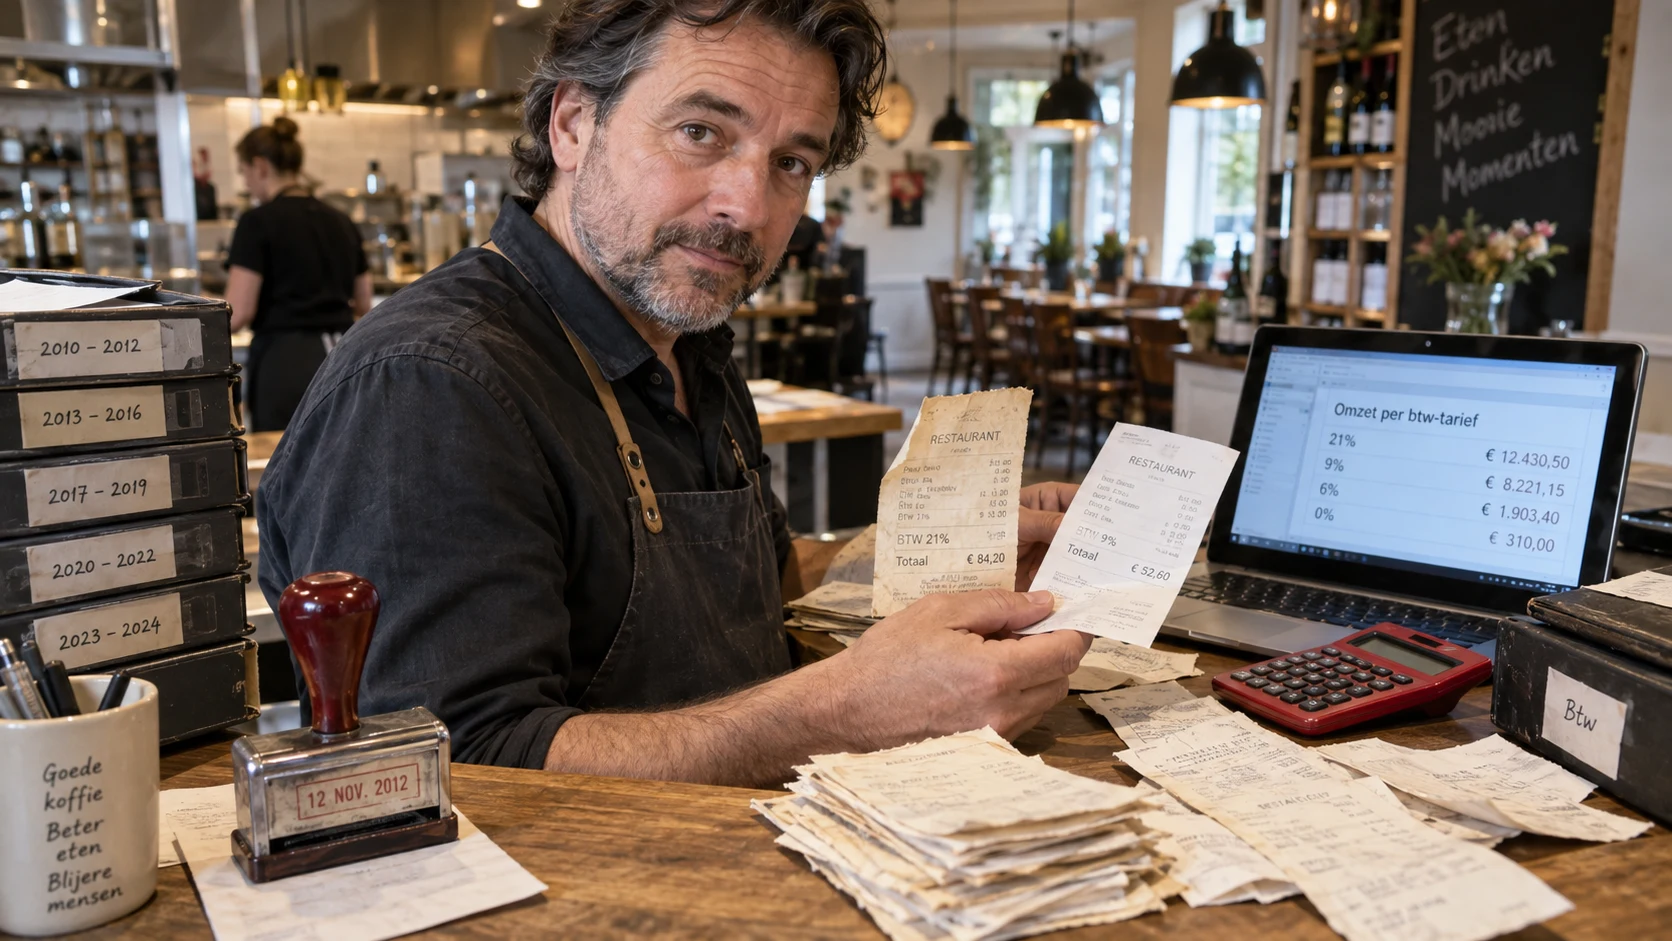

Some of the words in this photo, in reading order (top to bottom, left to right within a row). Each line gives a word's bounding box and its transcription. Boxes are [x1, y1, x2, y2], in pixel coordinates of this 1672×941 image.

[1431, 9, 1508, 62] Eten
[1434, 98, 1524, 160] Mooie
[1442, 130, 1580, 203] Momenten
[40, 341, 80, 357] 2010
[103, 338, 142, 354] 2012
[42, 409, 82, 427] 2013
[105, 404, 142, 422] 2016
[1334, 402, 1377, 419] Omzet
[1380, 409, 1404, 423] per
[1408, 408, 1479, 428] btw-tarief
[930, 430, 1001, 445] RESTAURANT
[1328, 432, 1356, 448] 21%
[1485, 448, 1496, 462] €
[1501, 450, 1570, 470] 12.430,50
[1128, 455, 1196, 480] RESTAURANT
[1324, 457, 1344, 472] 9%
[1485, 475, 1495, 489] €
[1503, 477, 1565, 497] 8.221,15
[48, 485, 88, 505] 2017
[111, 478, 147, 497] 2019
[1319, 482, 1339, 497] 6%
[1481, 502, 1491, 516] €
[1500, 505, 1560, 525] 1.903,40
[897, 534, 922, 545] BTW
[926, 533, 950, 545] 21%
[1075, 526, 1098, 541] BTW
[1100, 533, 1117, 547] 9%
[1314, 506, 1335, 521] 0%
[1489, 531, 1499, 545] €
[1506, 533, 1555, 553] 310,00
[52, 560, 95, 580] 2020
[117, 548, 157, 568] 2022
[896, 555, 929, 566] Totaal
[967, 554, 974, 565] €
[977, 552, 1006, 565] 84,20
[1067, 543, 1099, 562] Totaal
[1131, 563, 1139, 573] €
[1140, 565, 1171, 582] 52,60
[59, 628, 101, 651] 2023
[122, 616, 161, 638] 2024
[1563, 698, 1597, 732] Btw
[43, 756, 103, 787] Goede
[44, 785, 103, 813] koffie
[307, 790, 326, 809] 12
[334, 783, 368, 804] NOV.
[375, 774, 408, 796] 2012
[46, 818, 104, 843] Beter
[56, 842, 103, 862] eten
[47, 866, 113, 894] Blijere
[47, 886, 123, 914] mensen
